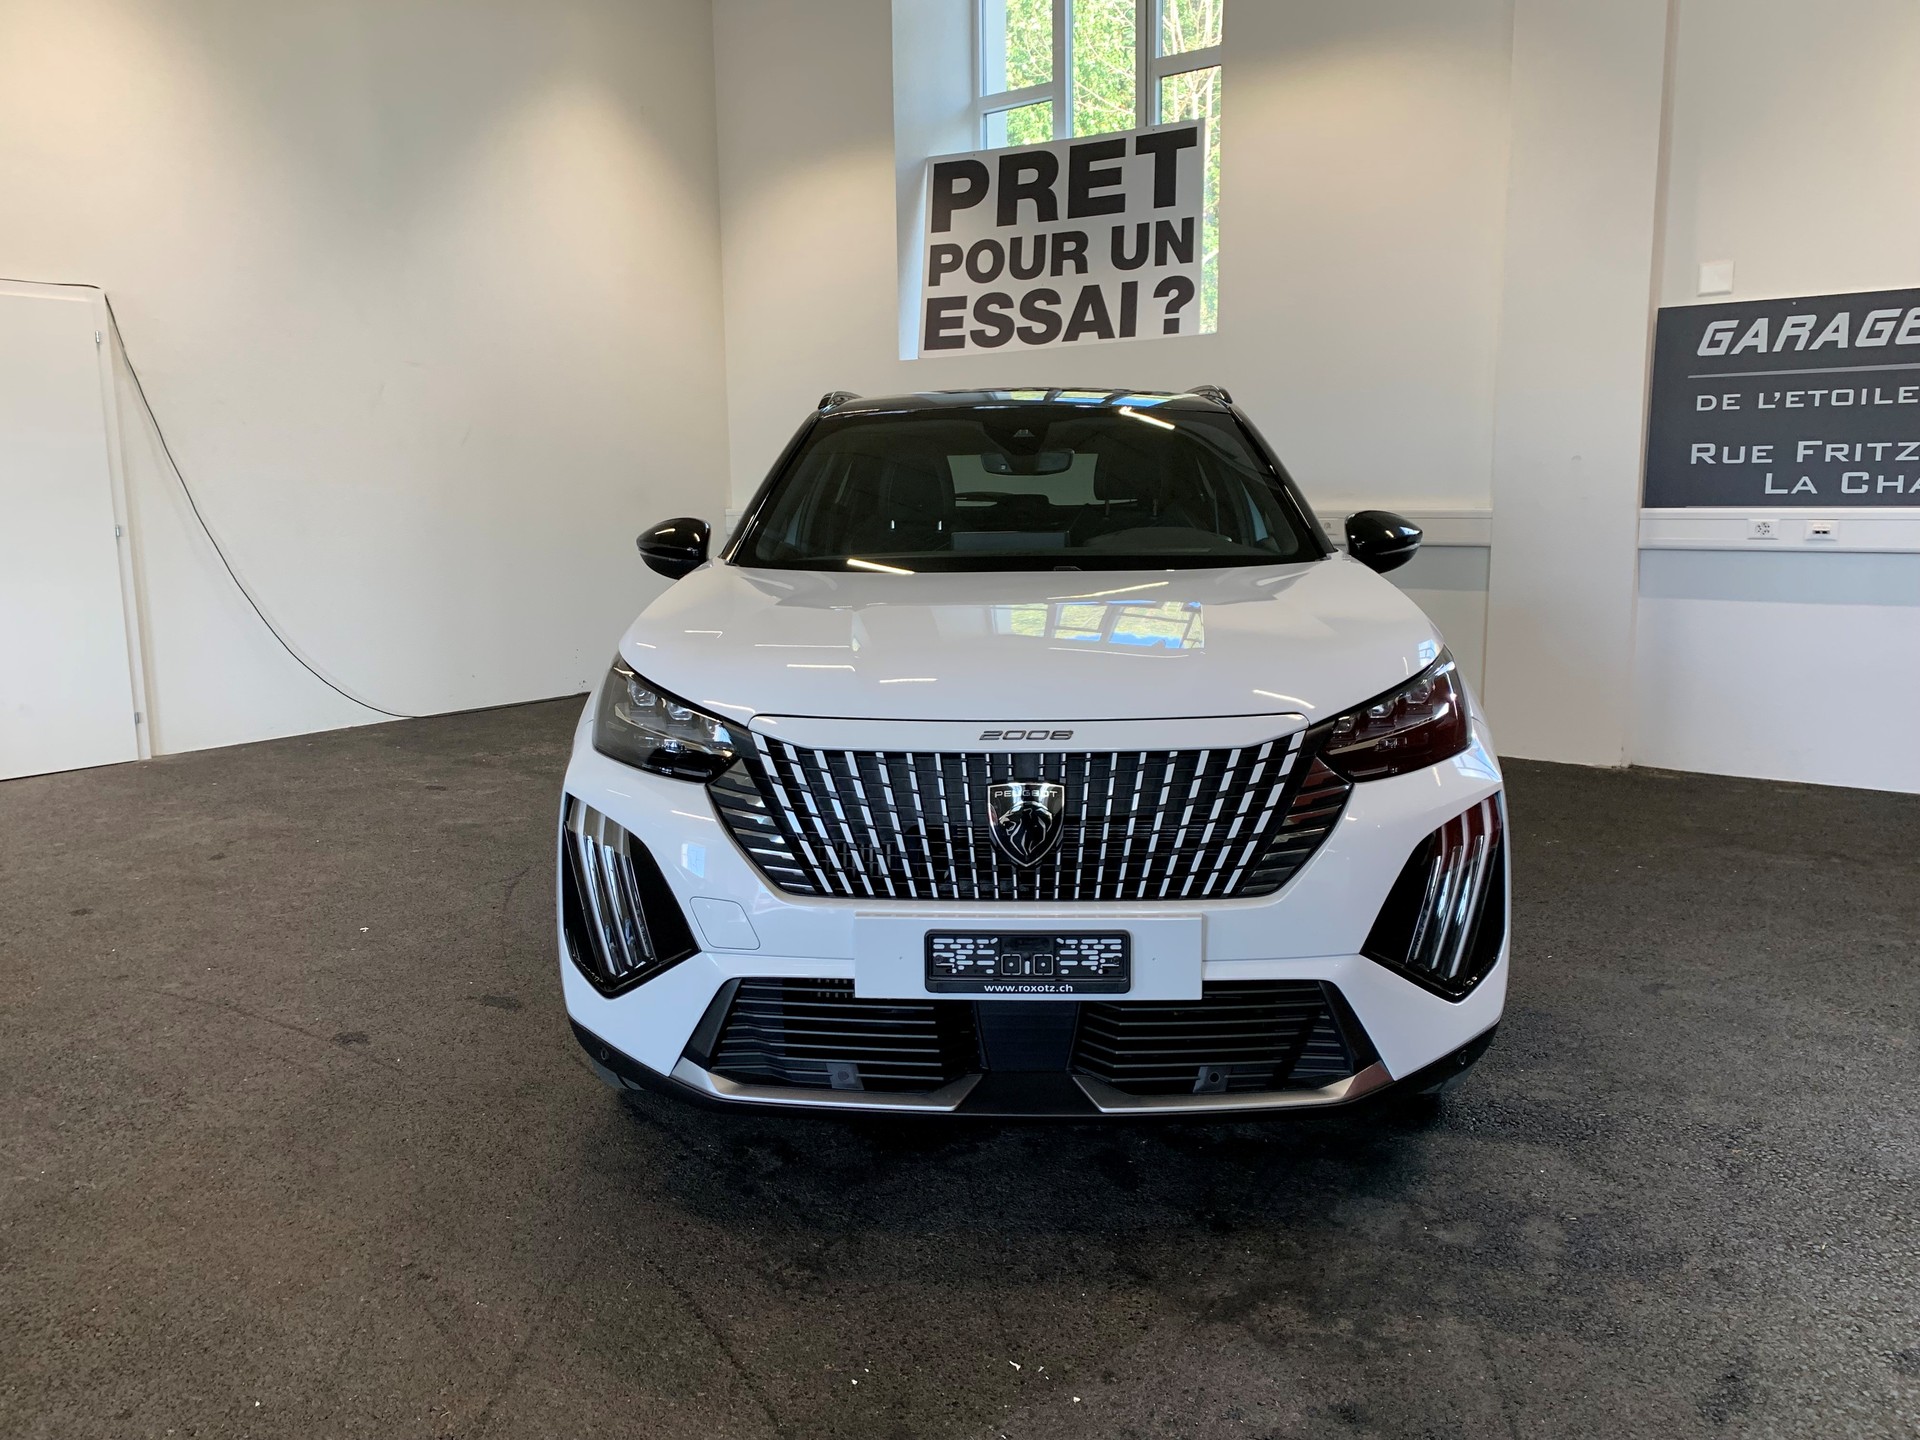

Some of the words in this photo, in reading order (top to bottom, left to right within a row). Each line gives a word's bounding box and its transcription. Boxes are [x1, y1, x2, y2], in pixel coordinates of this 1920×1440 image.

[931, 126, 1197, 233] PRET
[928, 230, 1089, 286] POUR
[1111, 216, 1195, 270] UN
[1697, 306, 1920, 356] GARAGE
[1696, 393, 1741, 411] DE
[1758, 386, 1920, 409] L'ETOILE
[1690, 443, 1774, 465] RUE
[1796, 440, 1920, 463] FRITZ
[1764, 472, 1818, 494] LA
[979, 730, 1074, 740] 2008
[984, 984, 1073, 993] www.roxotz.ch
